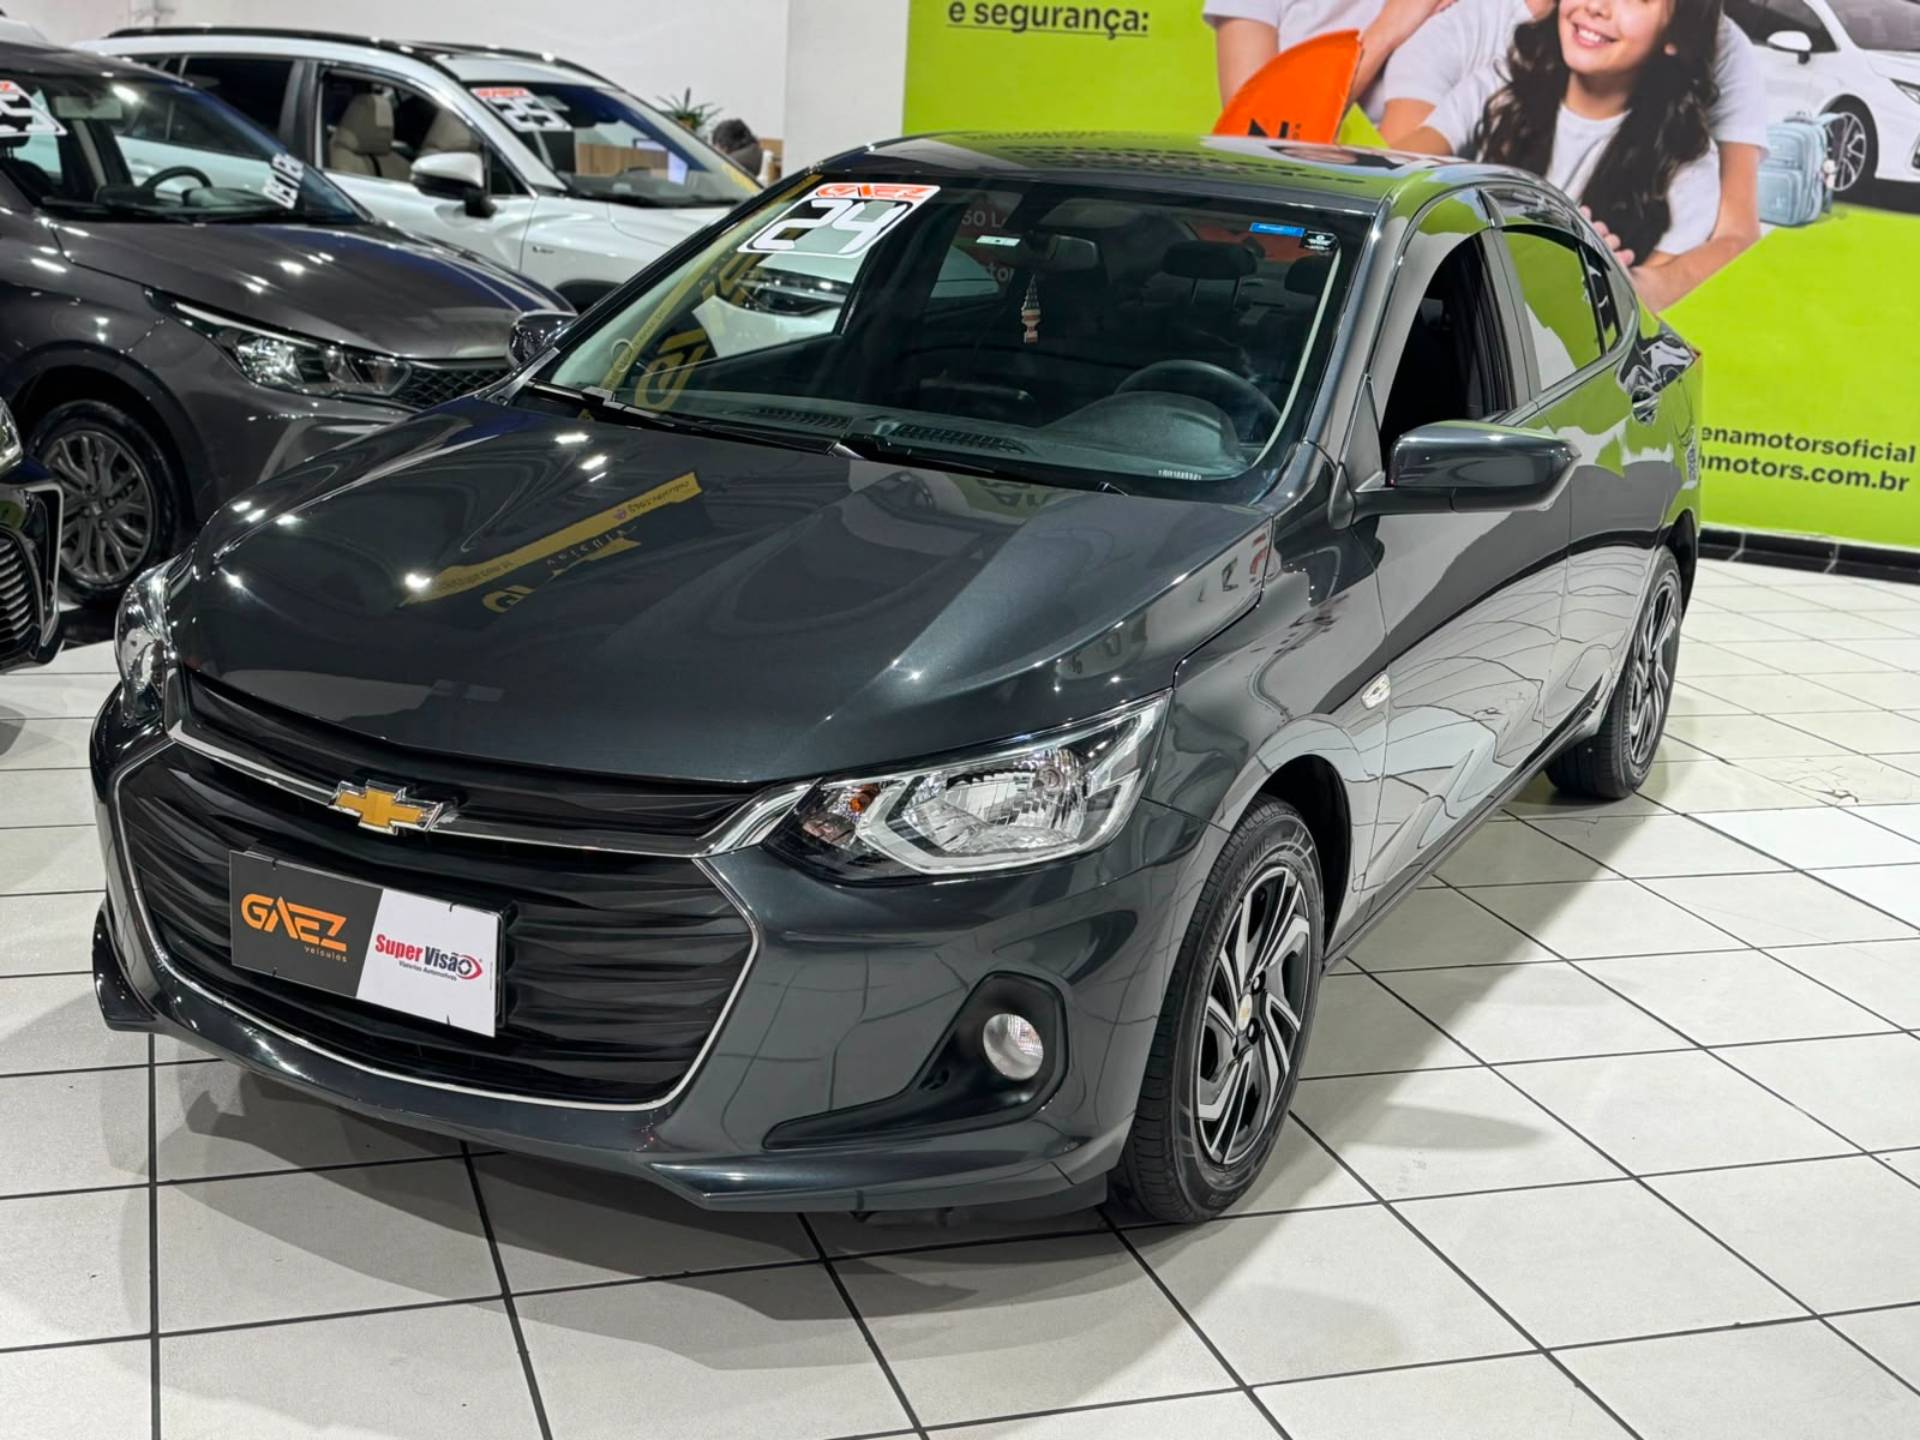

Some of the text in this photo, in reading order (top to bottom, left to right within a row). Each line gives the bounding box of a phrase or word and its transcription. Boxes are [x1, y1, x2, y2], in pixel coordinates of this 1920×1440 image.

[948, 1, 1149, 40] e segurança:
[752, 199, 908, 254] 24
[240, 893, 347, 952] GAEZ
[375, 934, 423, 963] Super
[425, 945, 473, 977] Visão
